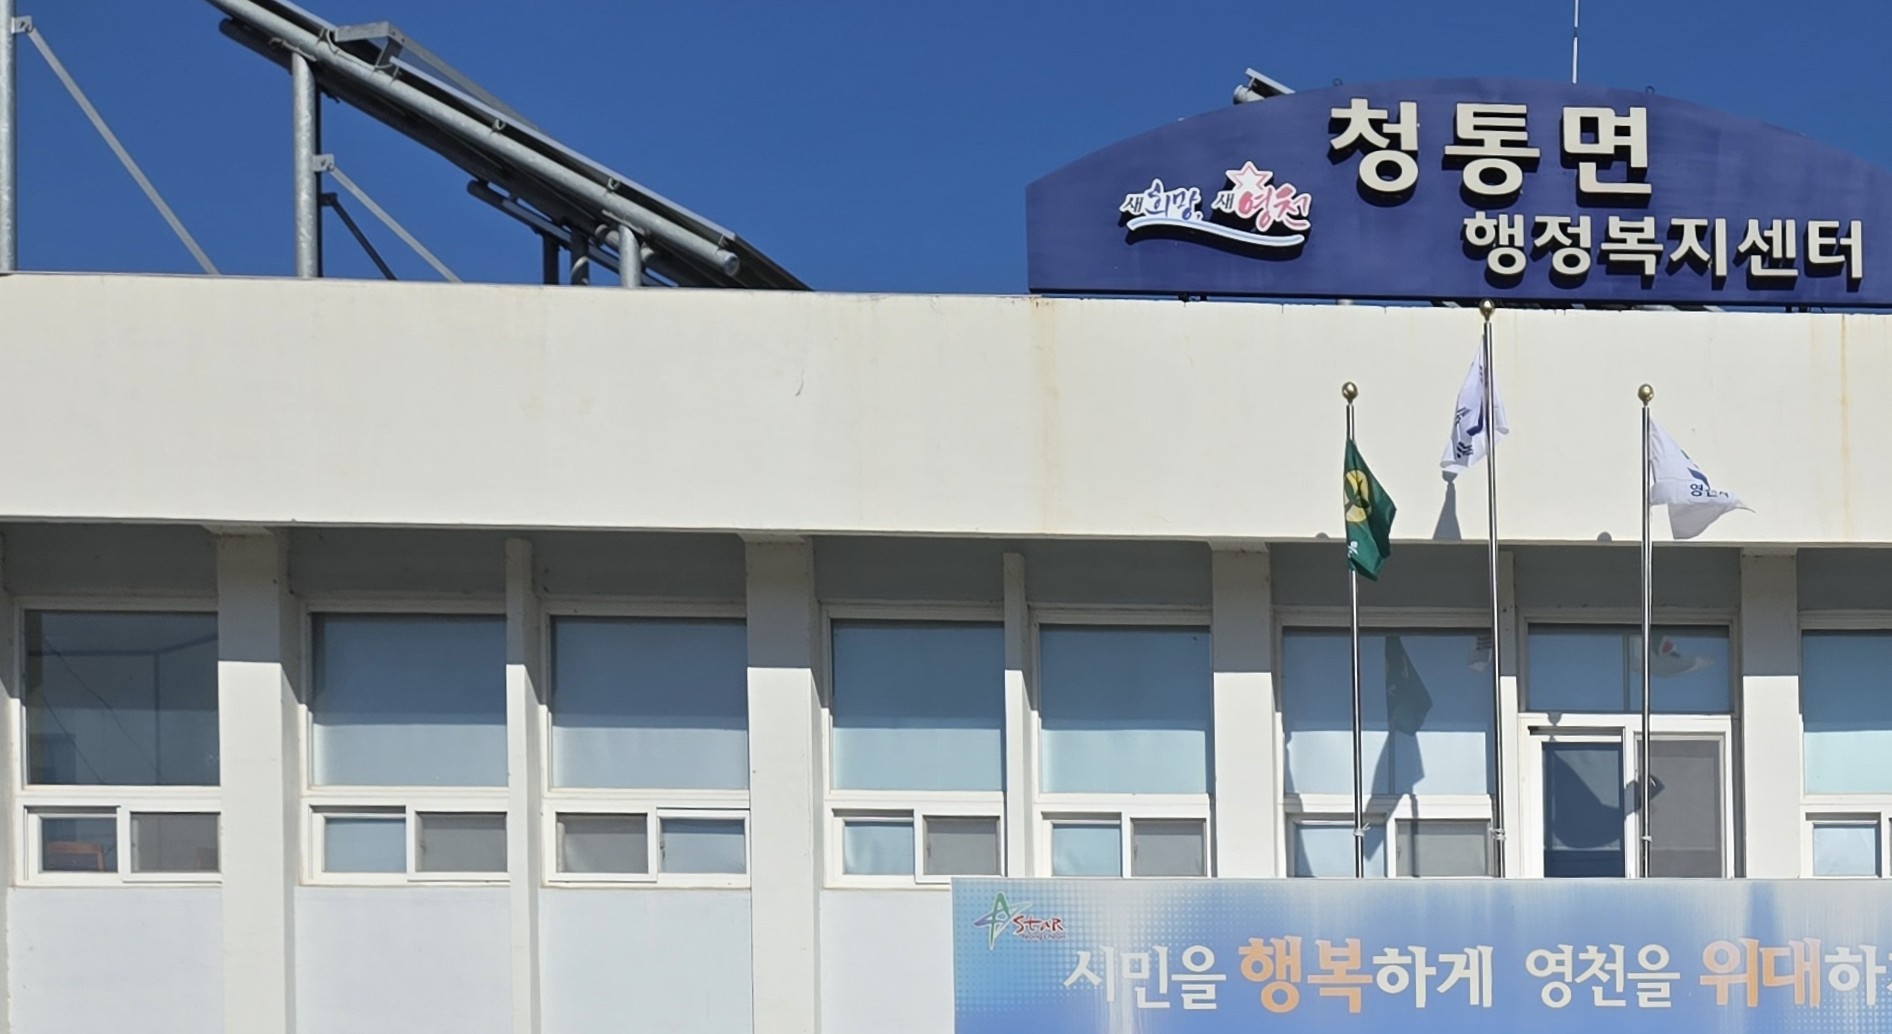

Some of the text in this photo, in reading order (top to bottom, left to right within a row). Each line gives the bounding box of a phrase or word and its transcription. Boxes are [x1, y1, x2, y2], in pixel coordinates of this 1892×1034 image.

[1330, 98, 1652, 197] 청통면
[1122, 195, 1143, 213] 새
[1215, 193, 1234, 210] 새
[1237, 184, 1310, 230] 영천
[1463, 213, 1863, 285] 행정복지센터
[1063, 944, 1227, 1011] 시민을
[1238, 935, 1494, 1014] 행복하게
[1525, 943, 1681, 1009] 영천을
